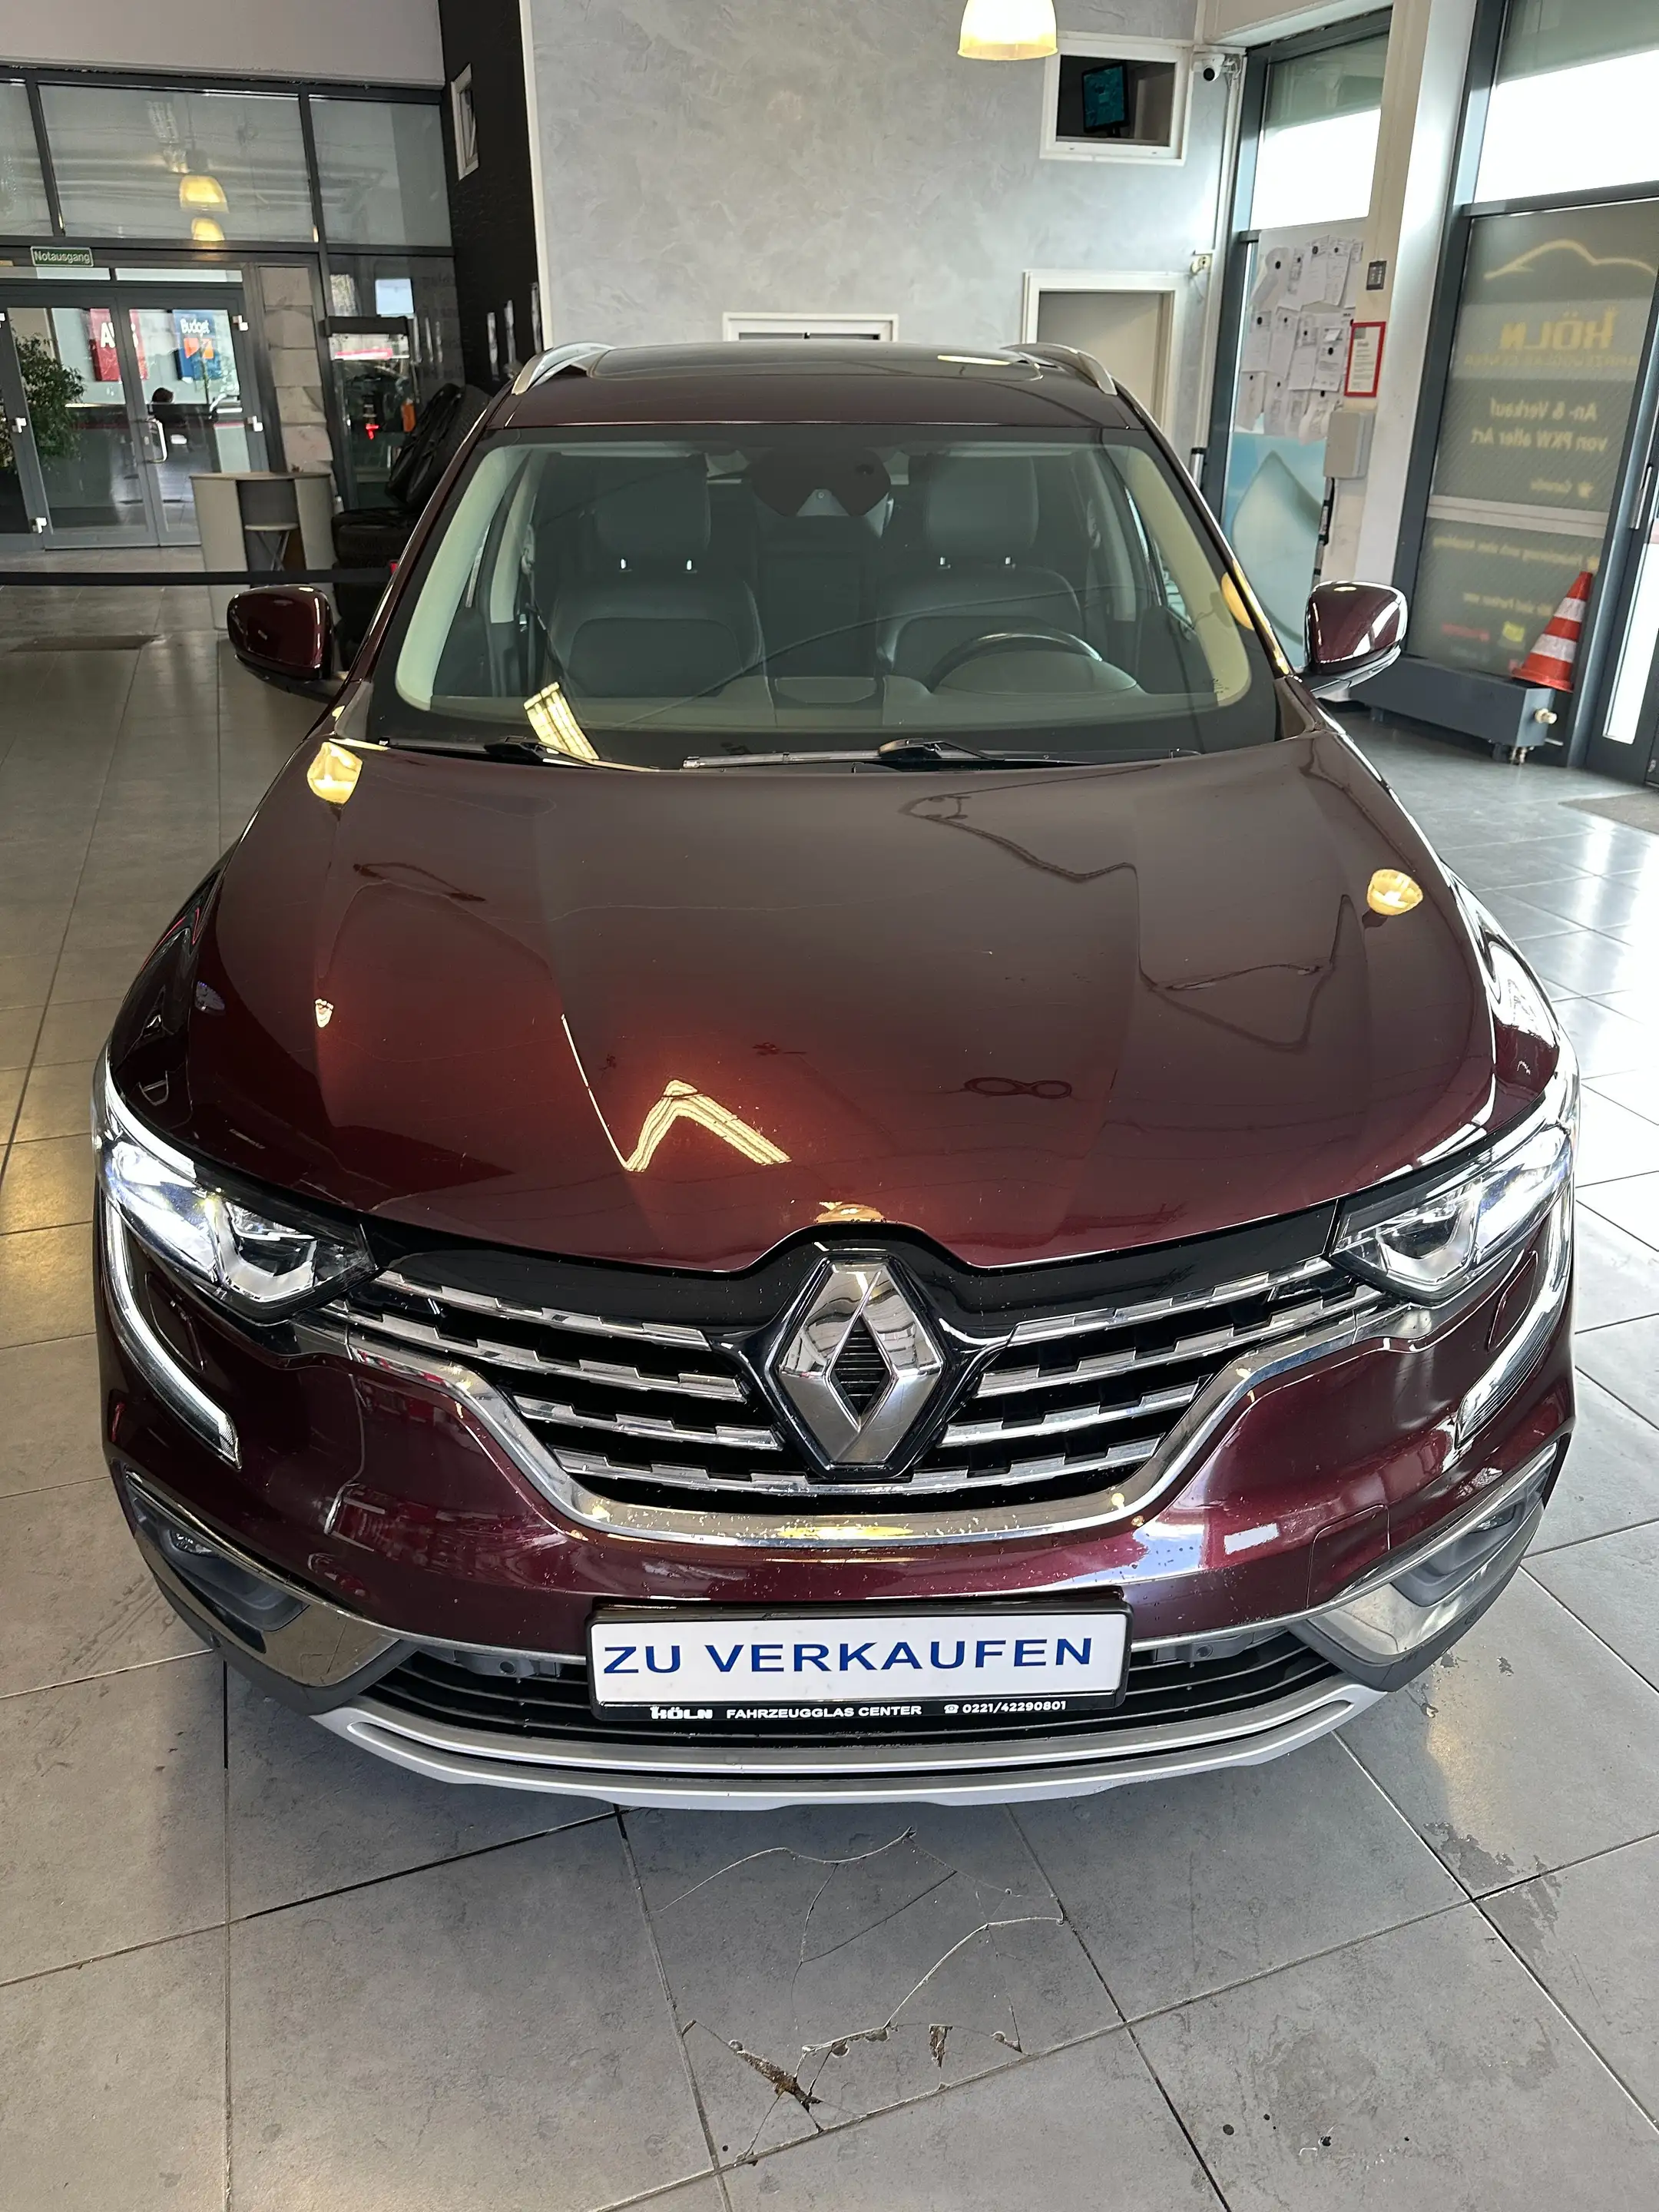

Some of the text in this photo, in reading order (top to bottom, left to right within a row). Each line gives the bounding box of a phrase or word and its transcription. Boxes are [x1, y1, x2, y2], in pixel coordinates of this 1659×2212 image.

[34, 250, 91, 264] Notausgang
[180, 318, 210, 338] Budget
[604, 1637, 1093, 1674] ZU VERKAUFEN
[727, 1707, 854, 1719] FAHRZEUGGLAS
[859, 1706, 922, 1717] CENTER
[962, 1700, 1067, 1714] 0221/42290801
